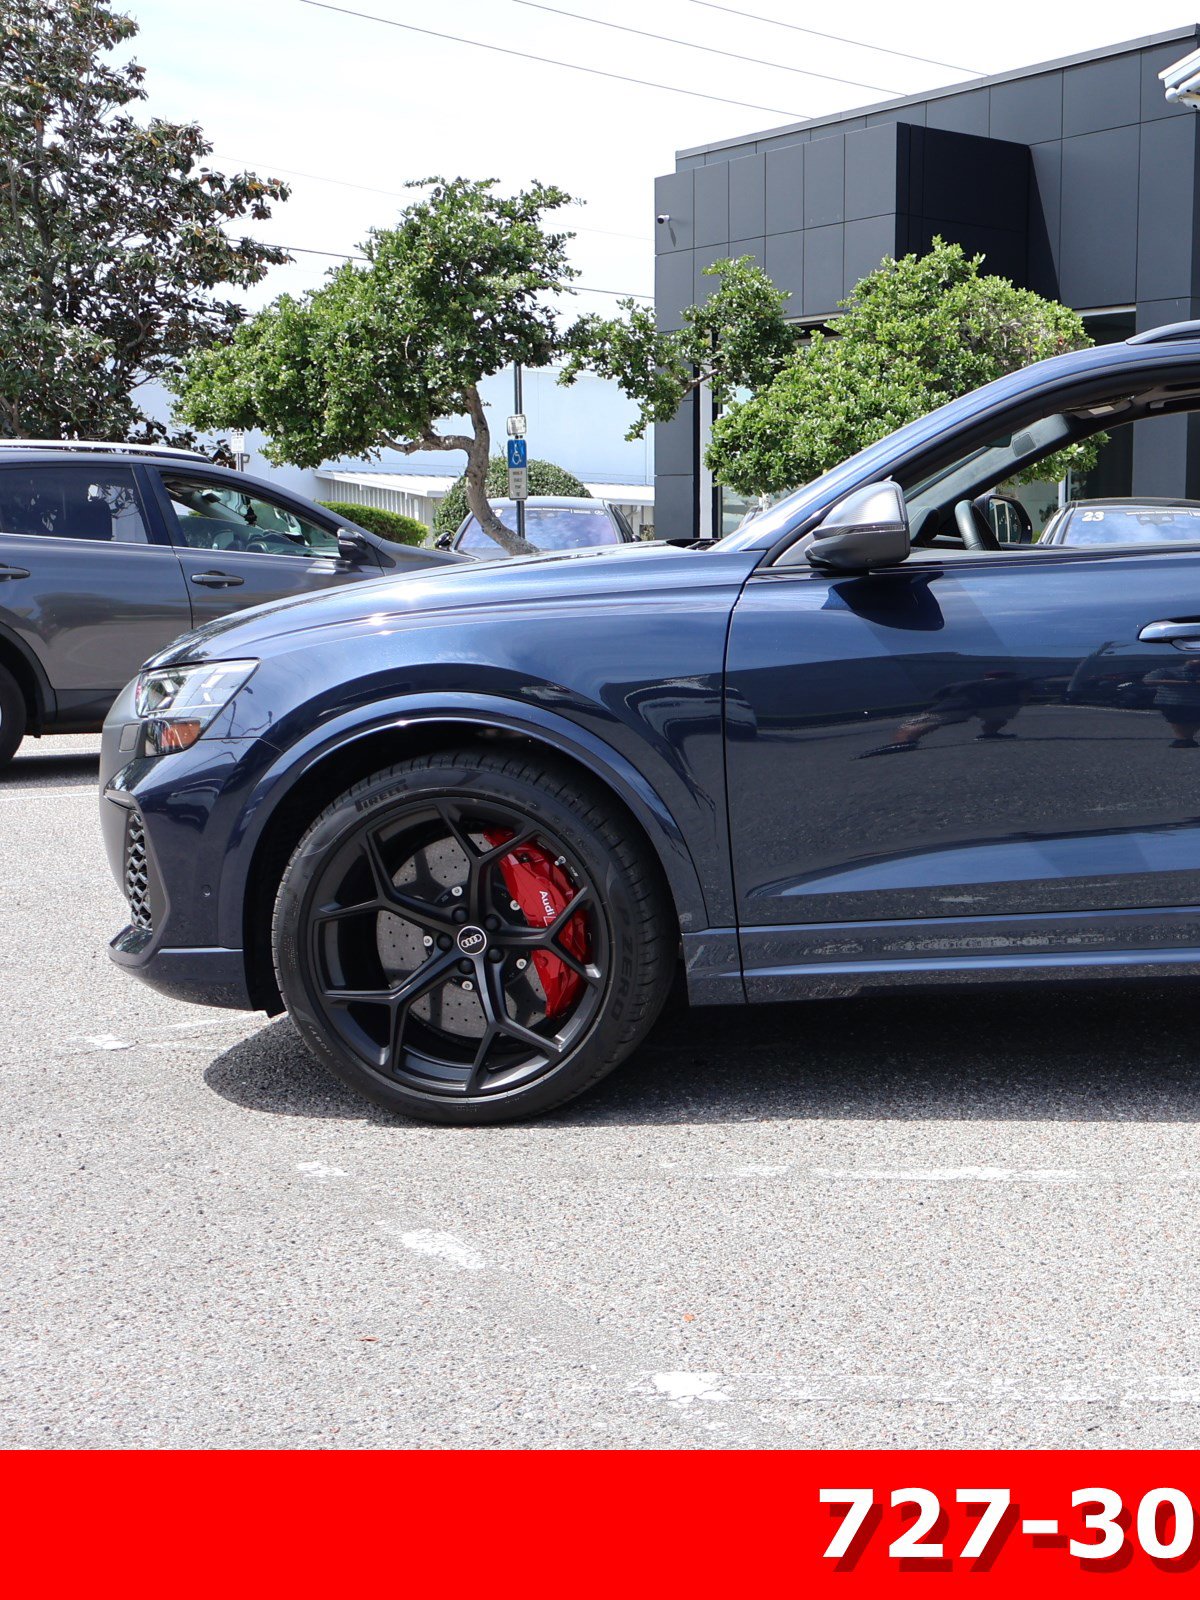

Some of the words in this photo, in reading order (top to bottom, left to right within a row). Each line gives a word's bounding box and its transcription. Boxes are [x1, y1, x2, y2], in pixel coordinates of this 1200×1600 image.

[1082, 511, 1104, 522] 23
[355, 778, 408, 812] PIRELLI
[539, 890, 555, 916] Audi
